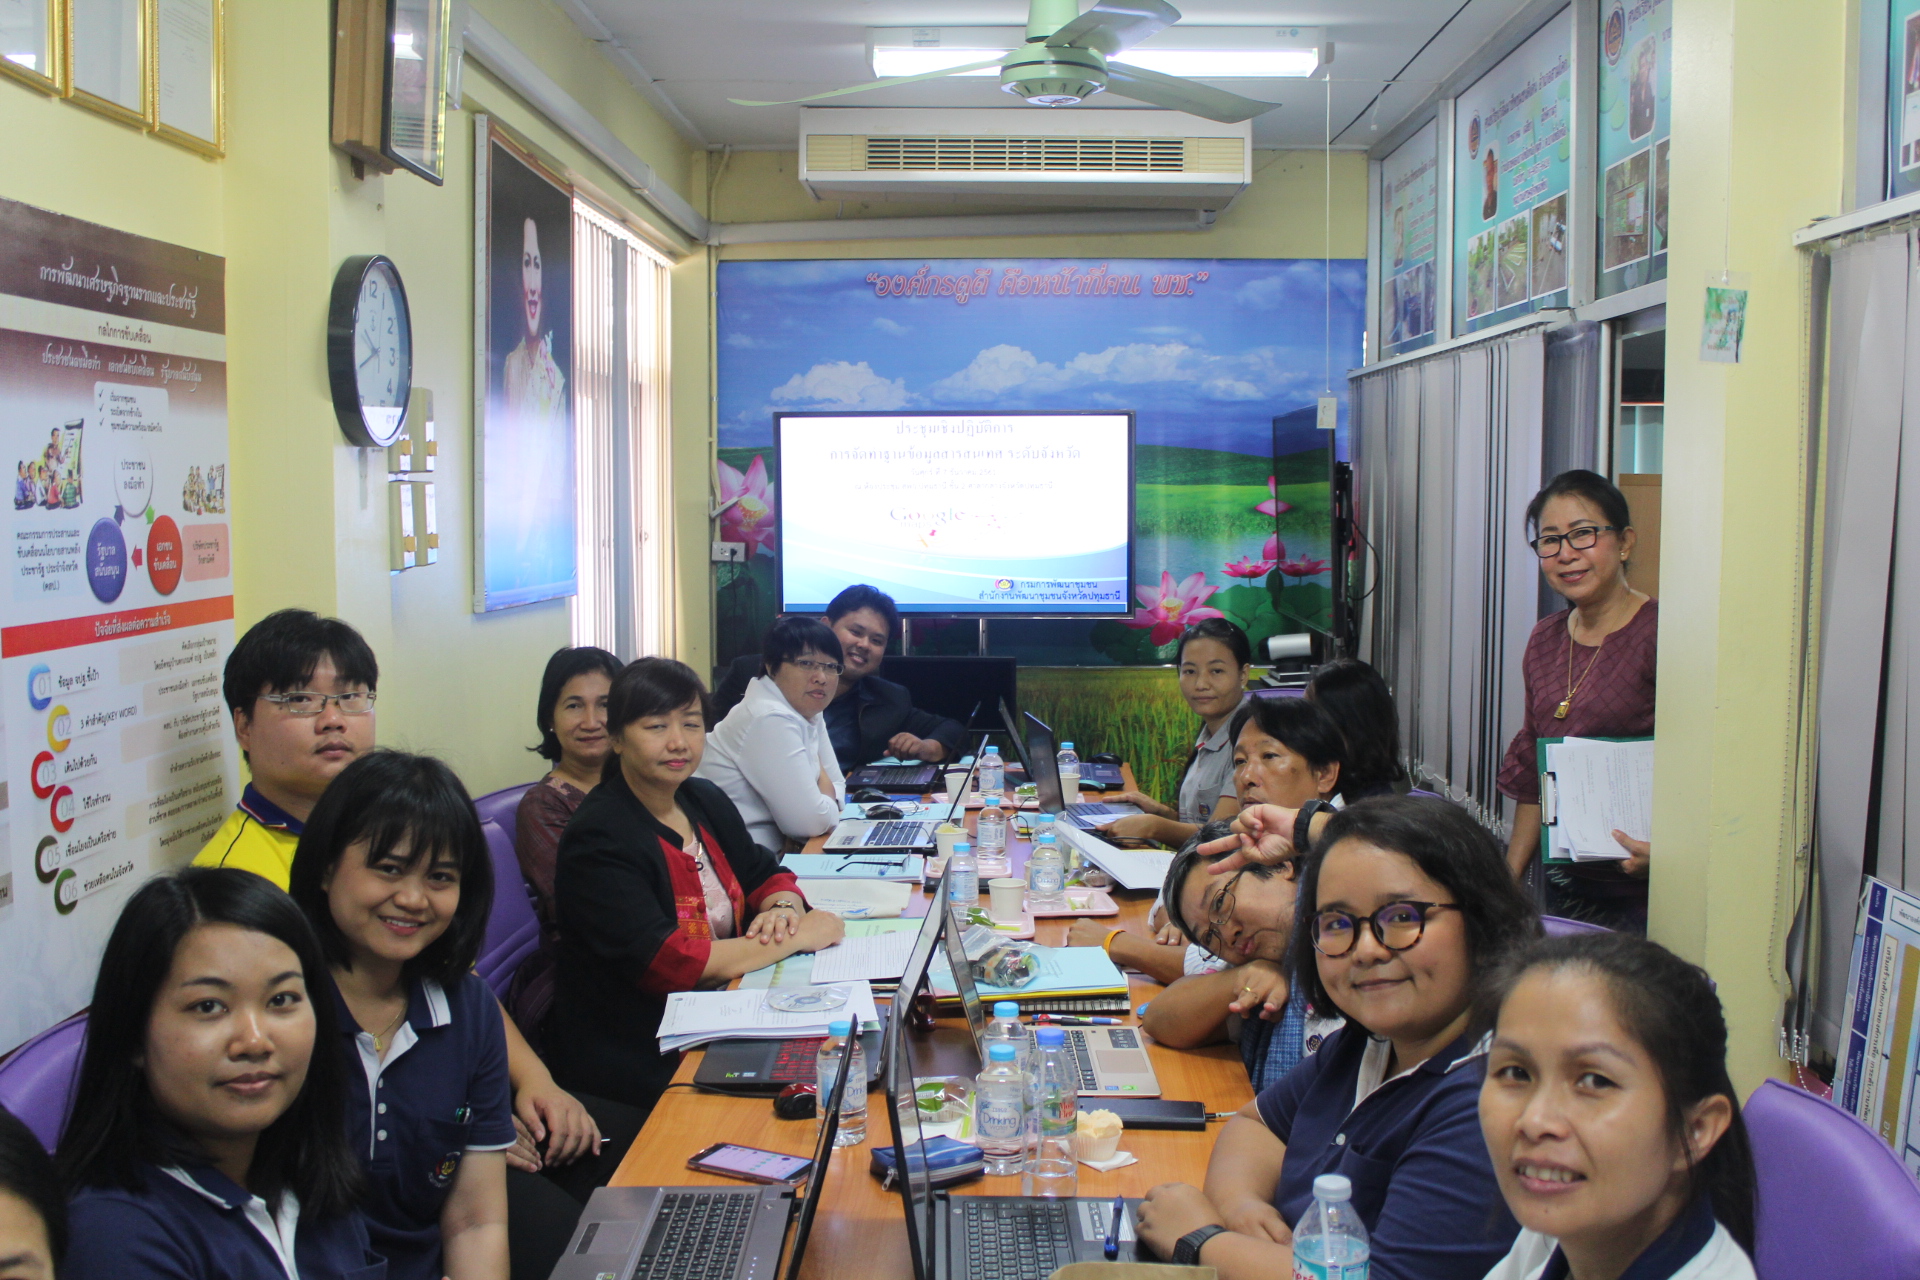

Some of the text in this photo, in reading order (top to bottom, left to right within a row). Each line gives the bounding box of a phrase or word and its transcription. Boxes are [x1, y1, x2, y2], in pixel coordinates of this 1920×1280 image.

[40, 256, 198, 318] การพัฒนาเศรษฐกิจฐานรากและประชารัฐ
[998, 263, 1141, 295] คือหน้าที่คน
[369, 279, 377, 298] 12
[98, 322, 151, 344] กลไกการขับเคลื่อน
[387, 317, 394, 335] 2
[389, 348, 396, 367] 3
[896, 419, 1014, 438] ประชุมเชิงปฏิบัติการ
[1008, 445, 1081, 459] ระดับจังหวัด
[121, 459, 146, 471] ประชาชน
[123, 476, 145, 490] ลงมือทำ
[890, 507, 966, 526] Google
[97, 543, 116, 561] รัฐบาล
[156, 541, 173, 551] เอกชน
[94, 562, 120, 580] สนับสนุน
[153, 555, 177, 571] ขับเคลื่อน
[1020, 578, 1098, 591] กรมการพัฒนาชุมชน
[978, 589, 1121, 602] สำนักงานพัฒนาชุมชนจังหวัดปทุมธานี
[57, 717, 72, 737] 02
[42, 762, 57, 784] 03
[64, 880, 78, 901] 06
[983, 1112, 1017, 1128] Drinking
